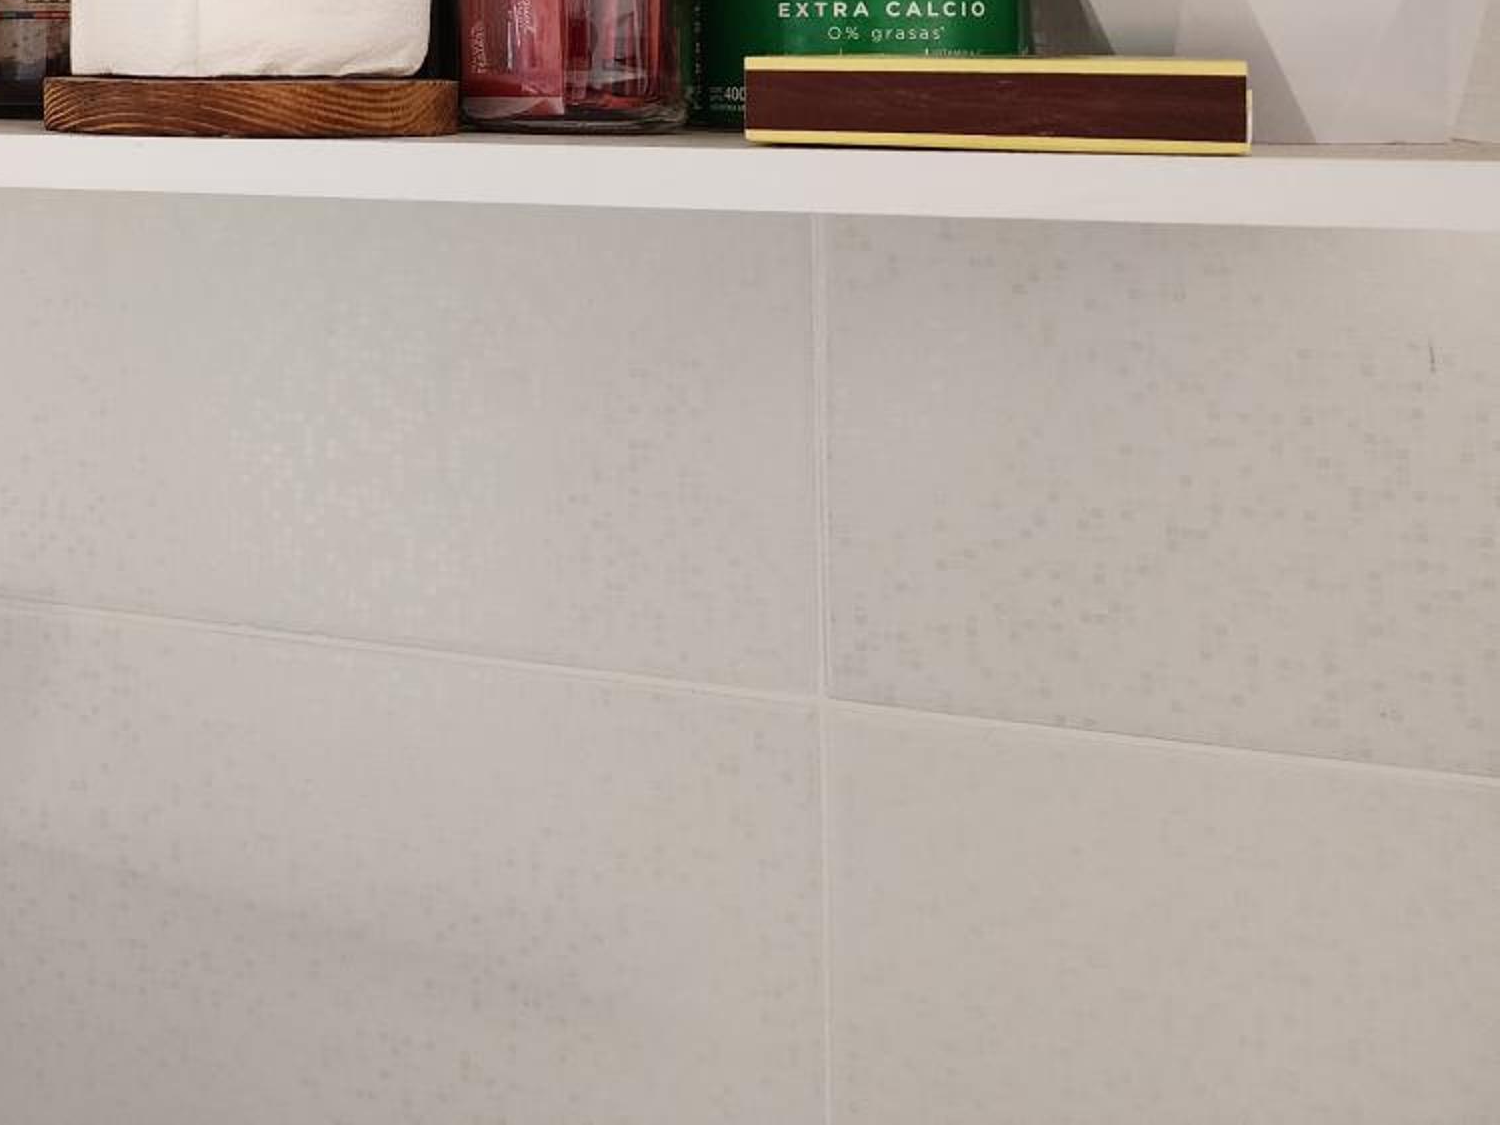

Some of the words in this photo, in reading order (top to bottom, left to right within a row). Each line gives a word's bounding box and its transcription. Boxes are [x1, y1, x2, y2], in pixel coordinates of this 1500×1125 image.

[777, 1, 869, 18] EXTRA
[885, 0, 986, 18] CALCIO
[827, 26, 859, 41] 0%
